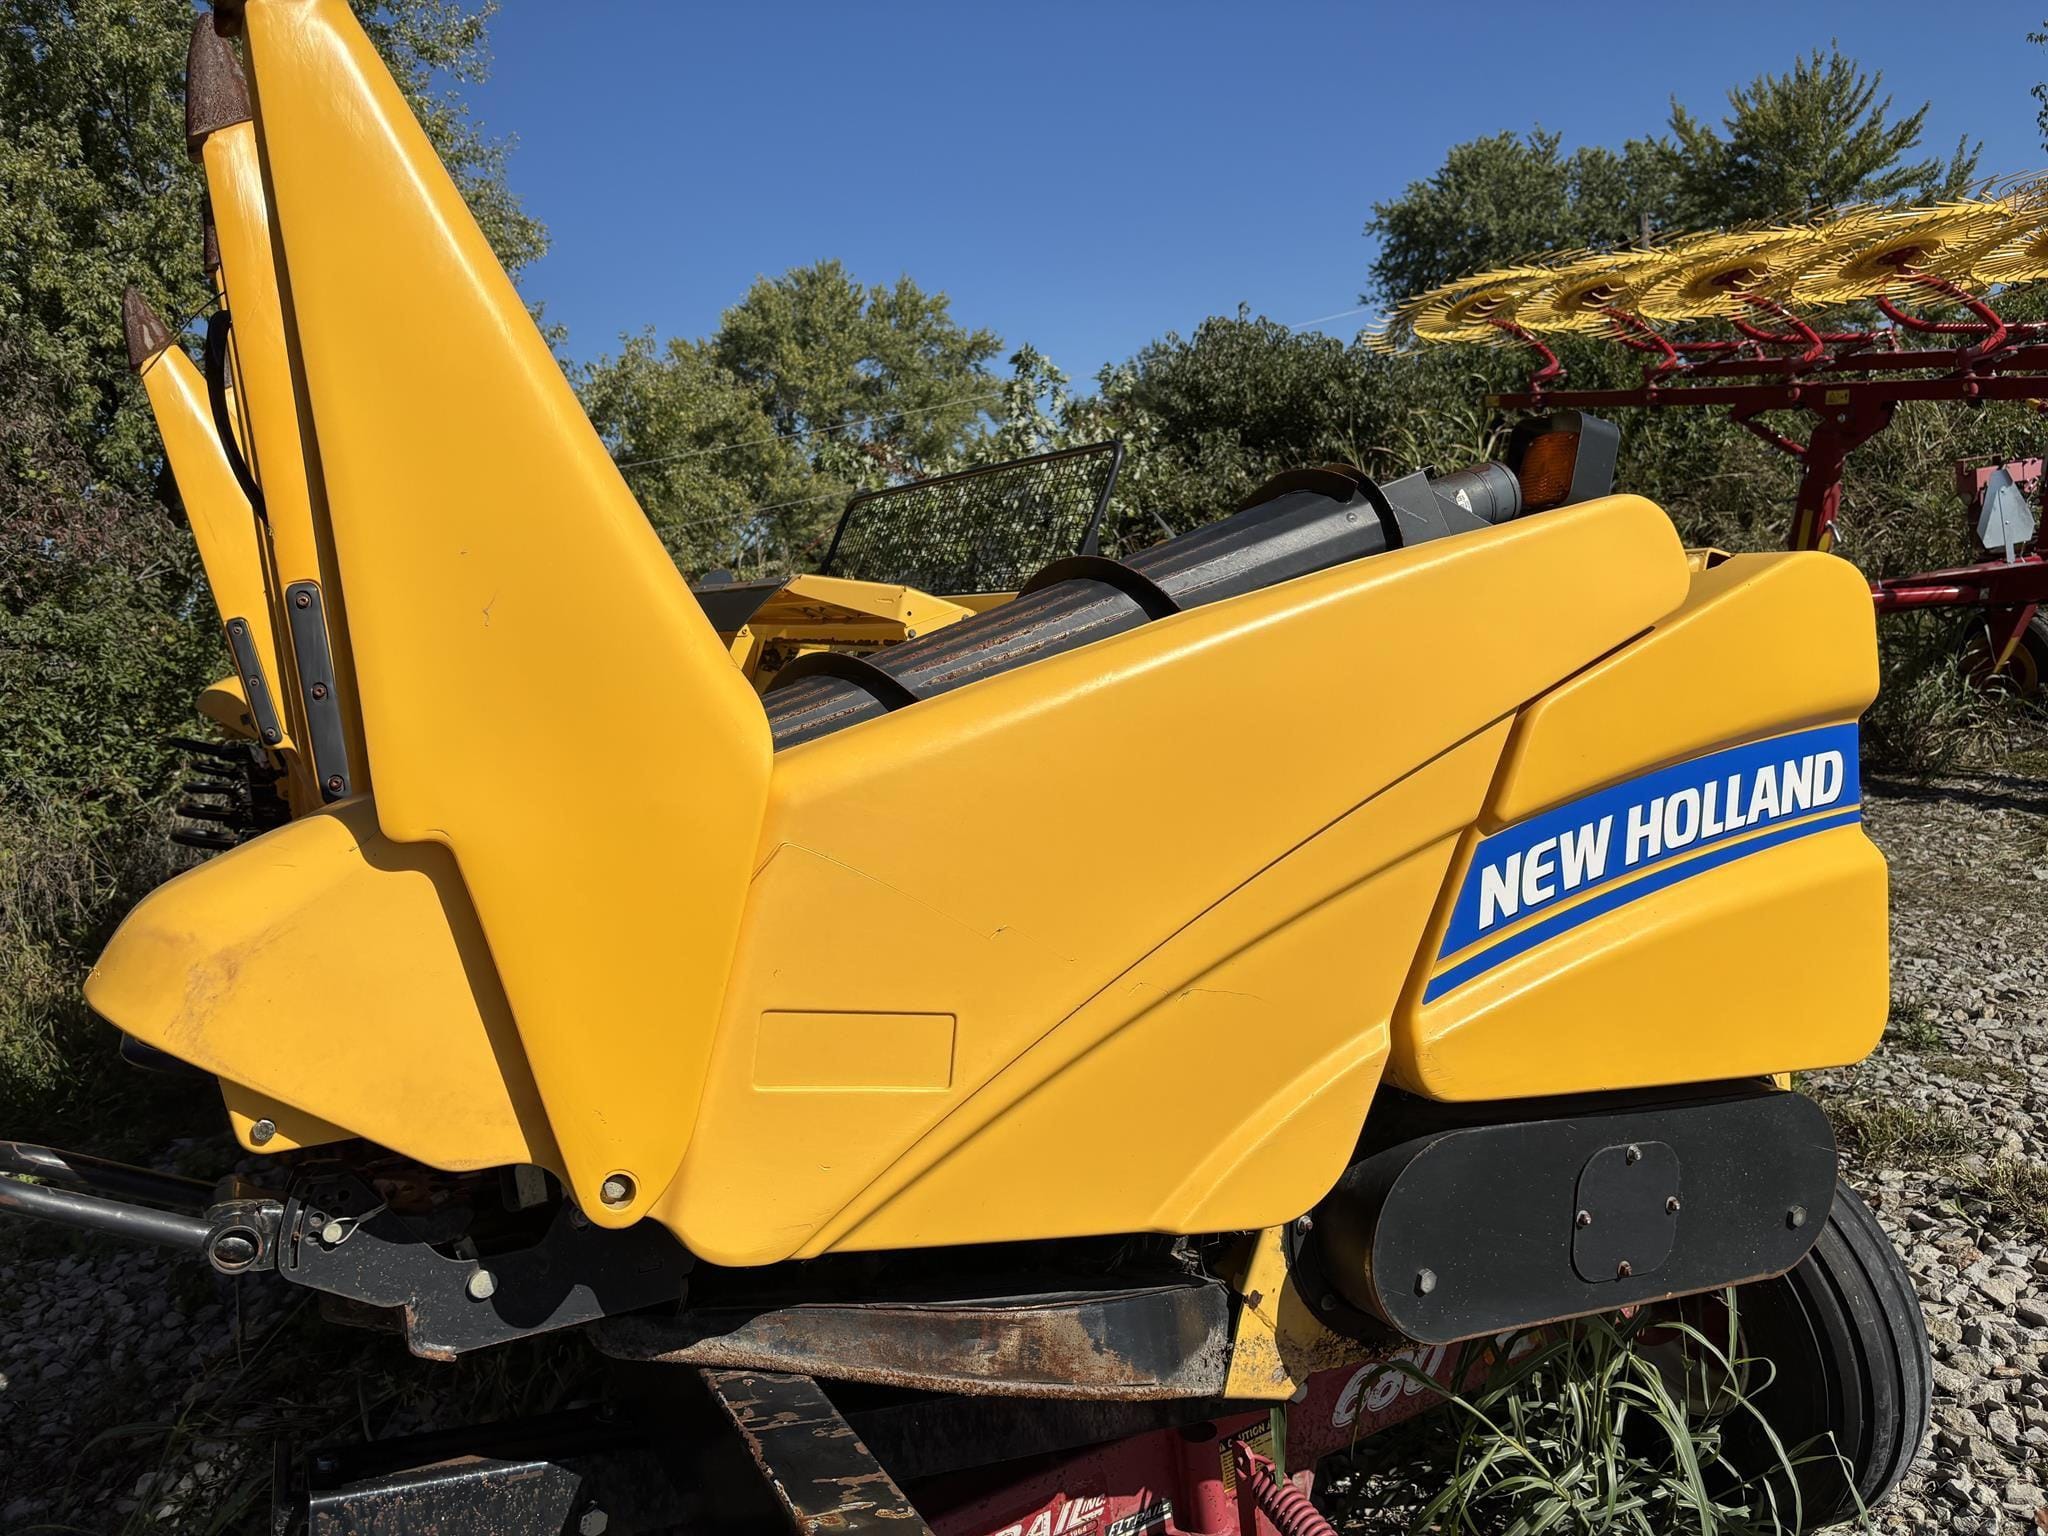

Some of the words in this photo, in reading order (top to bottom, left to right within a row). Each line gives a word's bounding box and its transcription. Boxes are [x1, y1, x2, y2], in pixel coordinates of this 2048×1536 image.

[1478, 814, 1614, 930] NEW
[1625, 750, 1845, 867] HOLLAND
[1228, 1423, 1265, 1448] CUTION
